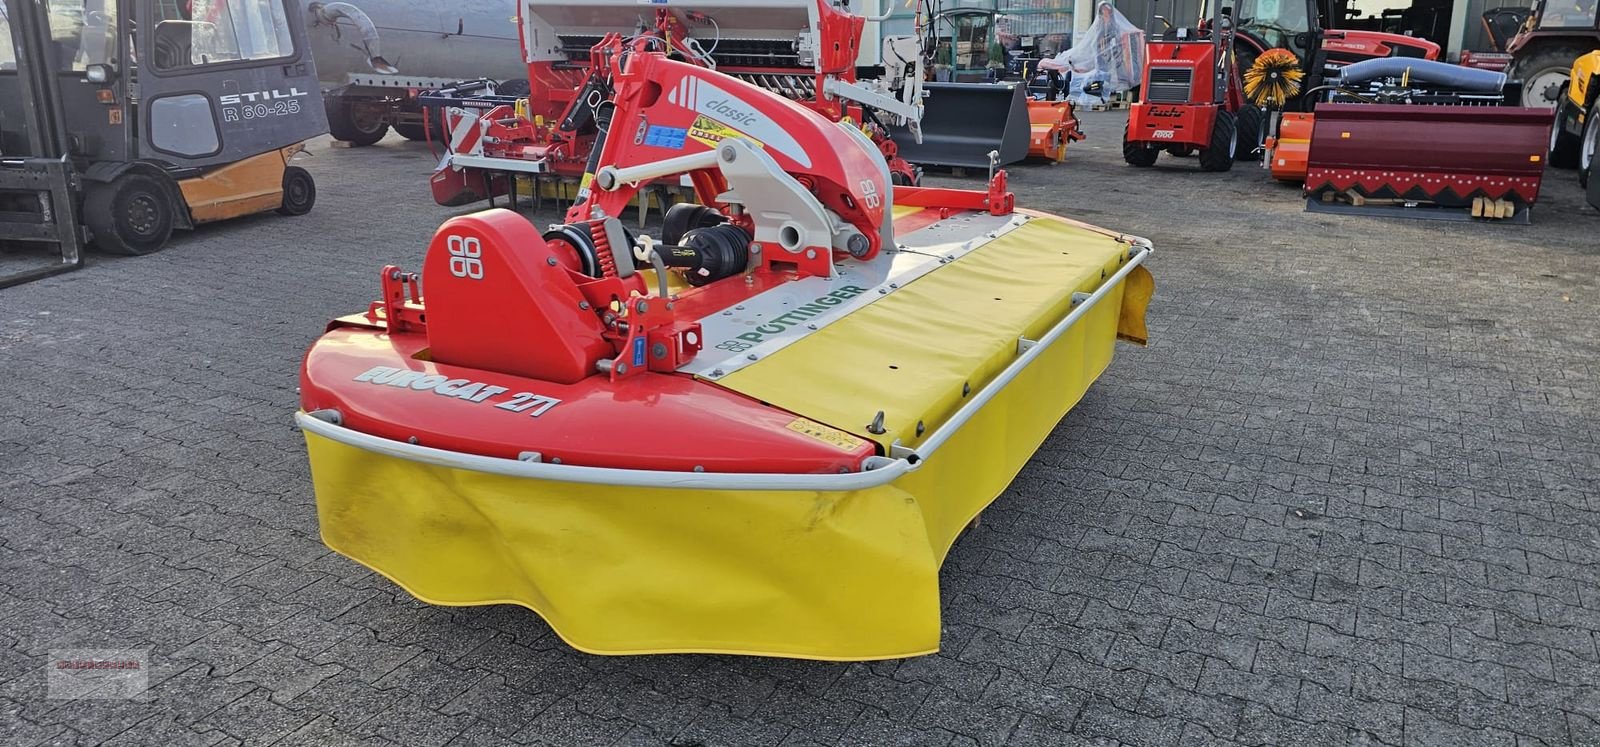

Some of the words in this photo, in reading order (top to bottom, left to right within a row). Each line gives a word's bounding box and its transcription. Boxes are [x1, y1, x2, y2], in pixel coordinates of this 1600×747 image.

[219, 87, 308, 105] STILL
[223, 107, 239, 122] R
[242, 99, 301, 119] 60-25
[705, 98, 757, 126] classic
[737, 285, 868, 343] PÖTTINGER
[353, 366, 508, 403] EUROCAT
[494, 391, 563, 417] 271
